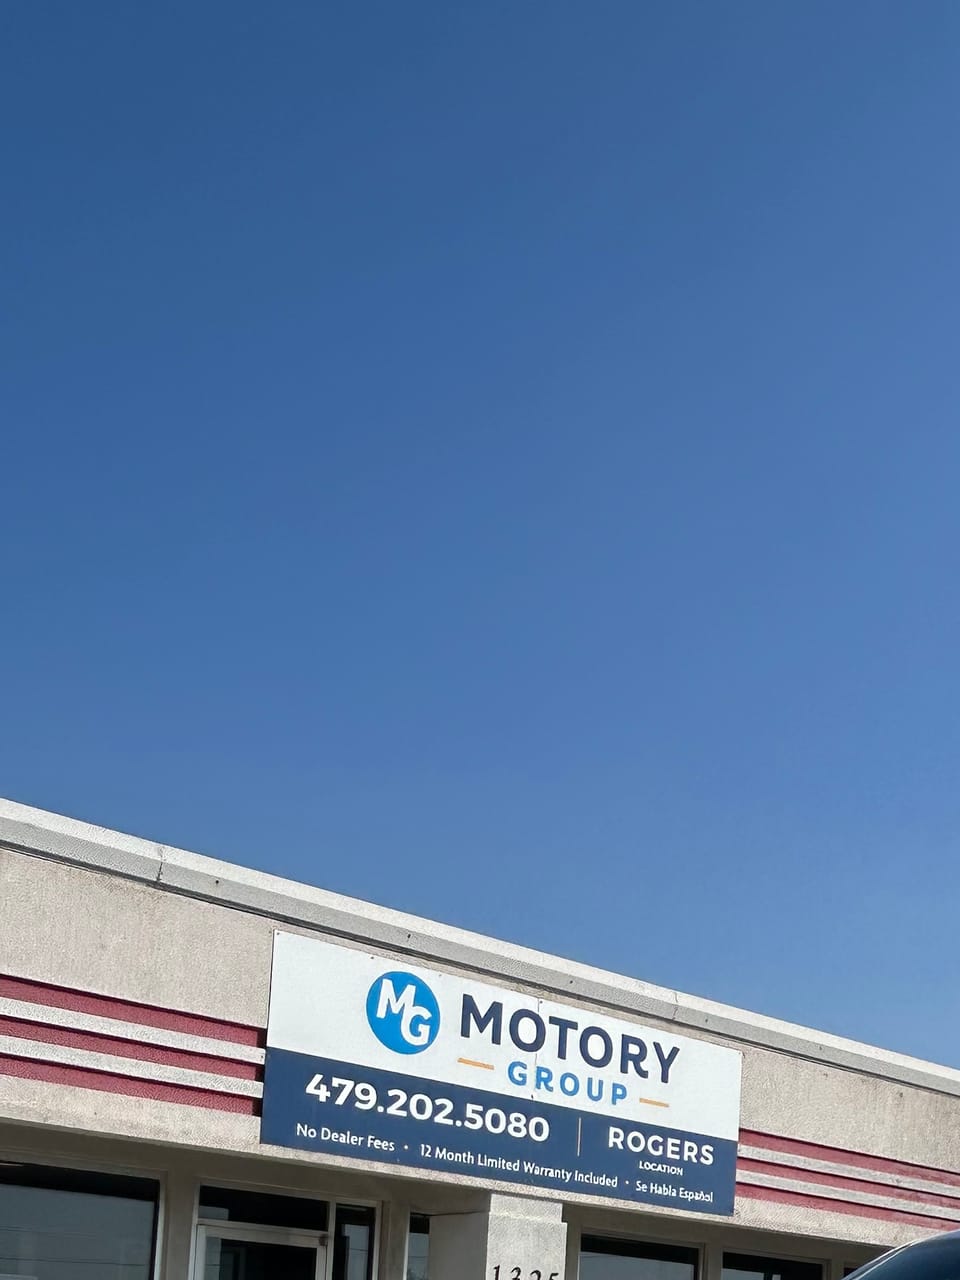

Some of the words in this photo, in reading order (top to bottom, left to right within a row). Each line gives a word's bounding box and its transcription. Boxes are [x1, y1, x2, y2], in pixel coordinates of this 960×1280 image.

[375, 978, 432, 1046] MG
[460, 993, 680, 1084] MOTORY
[305, 1073, 550, 1142] 479.202.5080
[507, 1060, 628, 1105] GROUP
[296, 1122, 317, 1138] No
[321, 1126, 364, 1146] Dealer
[367, 1134, 396, 1151] Fees
[420, 1143, 432, 1158] 12
[435, 1147, 475, 1165] Month
[477, 1153, 520, 1172] Limited
[523, 1160, 572, 1182] Warranty
[574, 1168, 618, 1188] Included
[635, 1180, 648, 1193] Se
[650, 1182, 677, 1197] Habla
[608, 1126, 714, 1165] ROGERS
[638, 1160, 684, 1176] LOCATION
